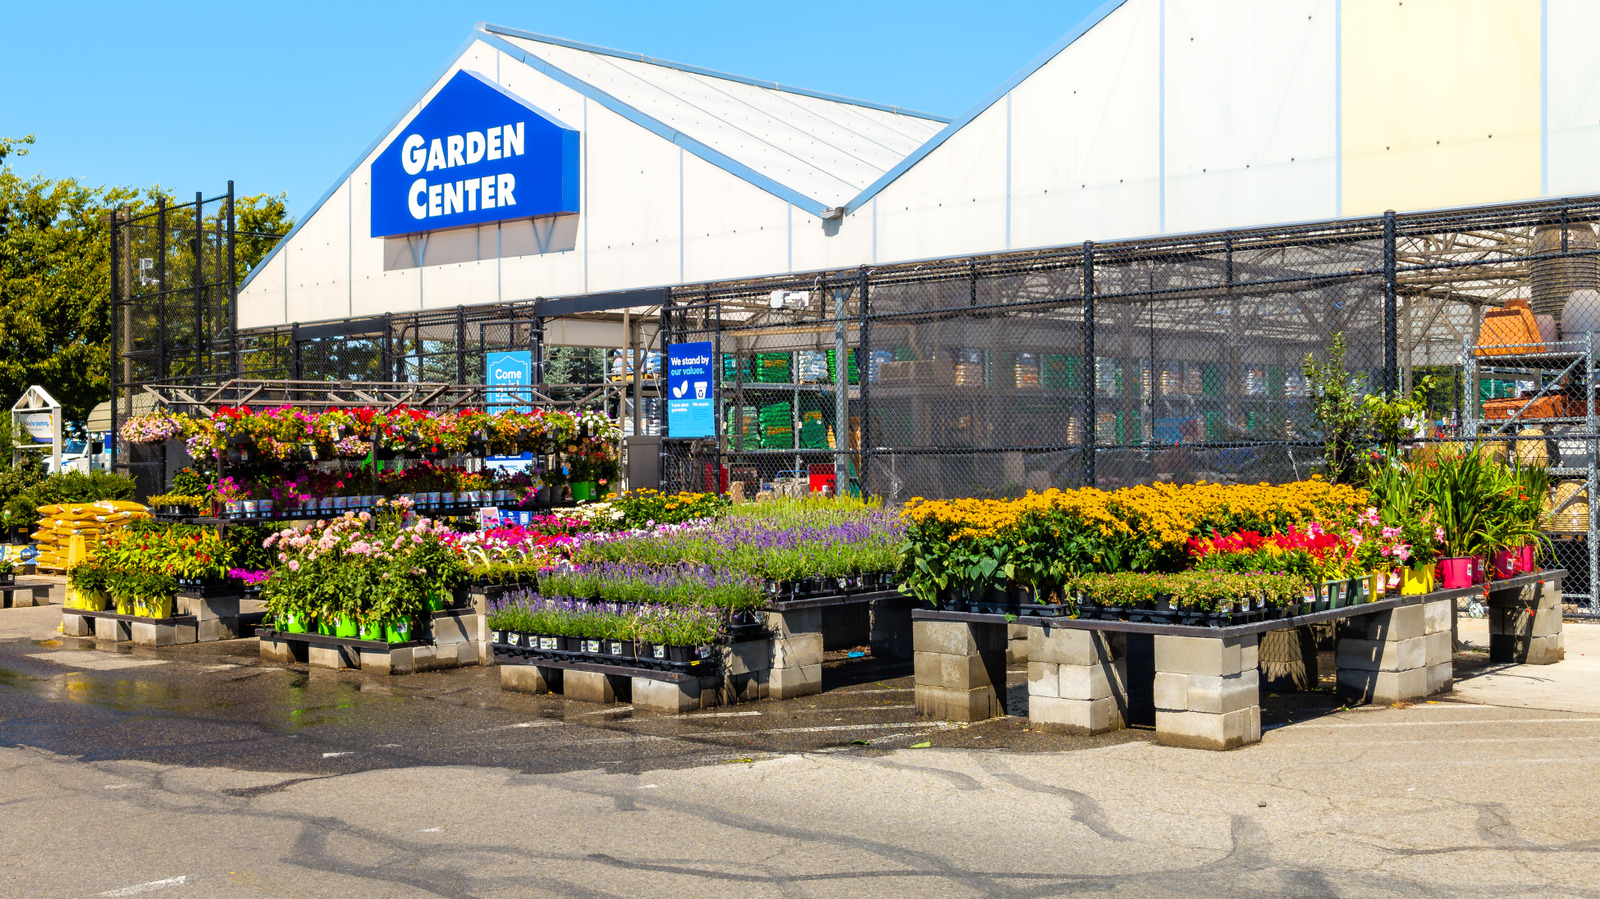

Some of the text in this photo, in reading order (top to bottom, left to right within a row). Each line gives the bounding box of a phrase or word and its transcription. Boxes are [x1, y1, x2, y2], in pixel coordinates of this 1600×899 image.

[401, 121, 525, 175] GARDEN
[408, 173, 517, 220] CENTER
[671, 355, 709, 366] We stand by
[495, 368, 522, 380] Come
[683, 366, 705, 375] values.
